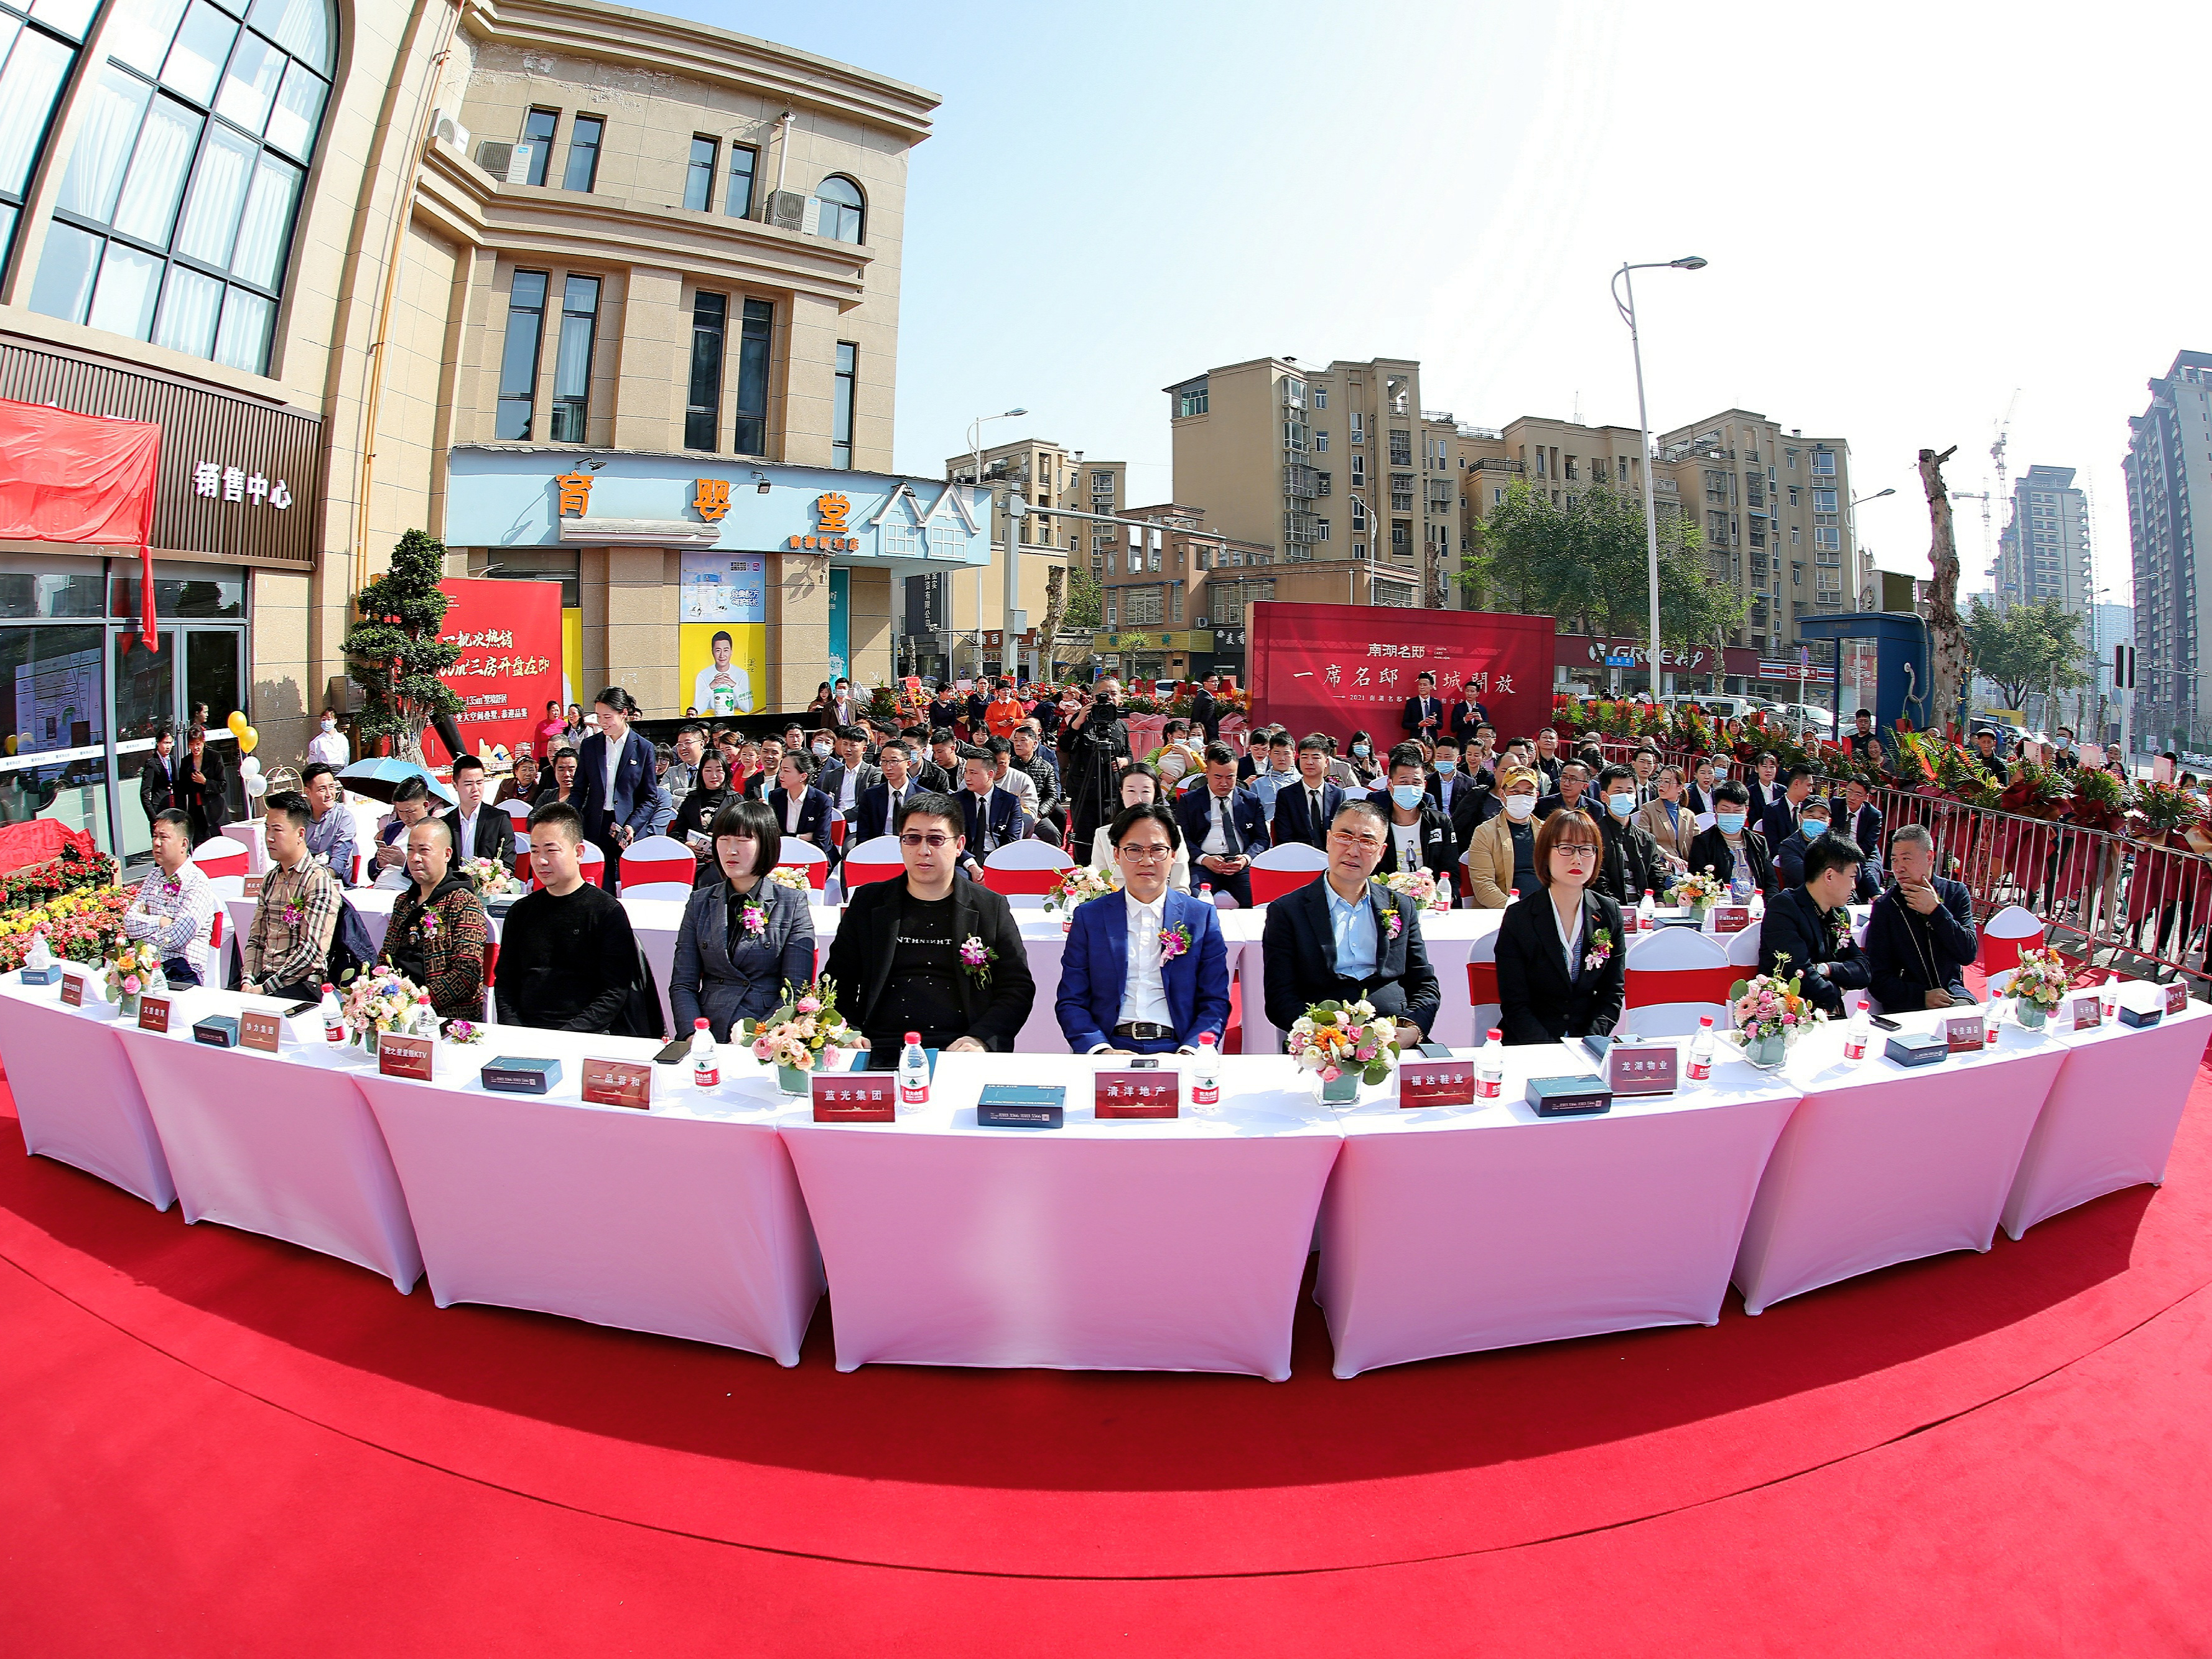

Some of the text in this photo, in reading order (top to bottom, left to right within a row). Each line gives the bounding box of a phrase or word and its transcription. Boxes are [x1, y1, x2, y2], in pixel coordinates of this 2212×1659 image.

[192, 460, 293, 510] 销售中心
[556, 471, 850, 533] 育婴堂
[442, 628, 513, 649] 一批次热销
[1367, 643, 1425, 659] 南湖名邸
[1293, 664, 1399, 689] 一席名邸
[246, 1022, 274, 1034] 协力集团
[1622, 1060, 1667, 1071] 龙湖物业
[592, 1074, 640, 1087] 一品蓉和
[1411, 1074, 1464, 1086] 福达鞋业
[824, 1090, 882, 1102] 蓝光集团
[1107, 1085, 1166, 1097] 清洋地产
